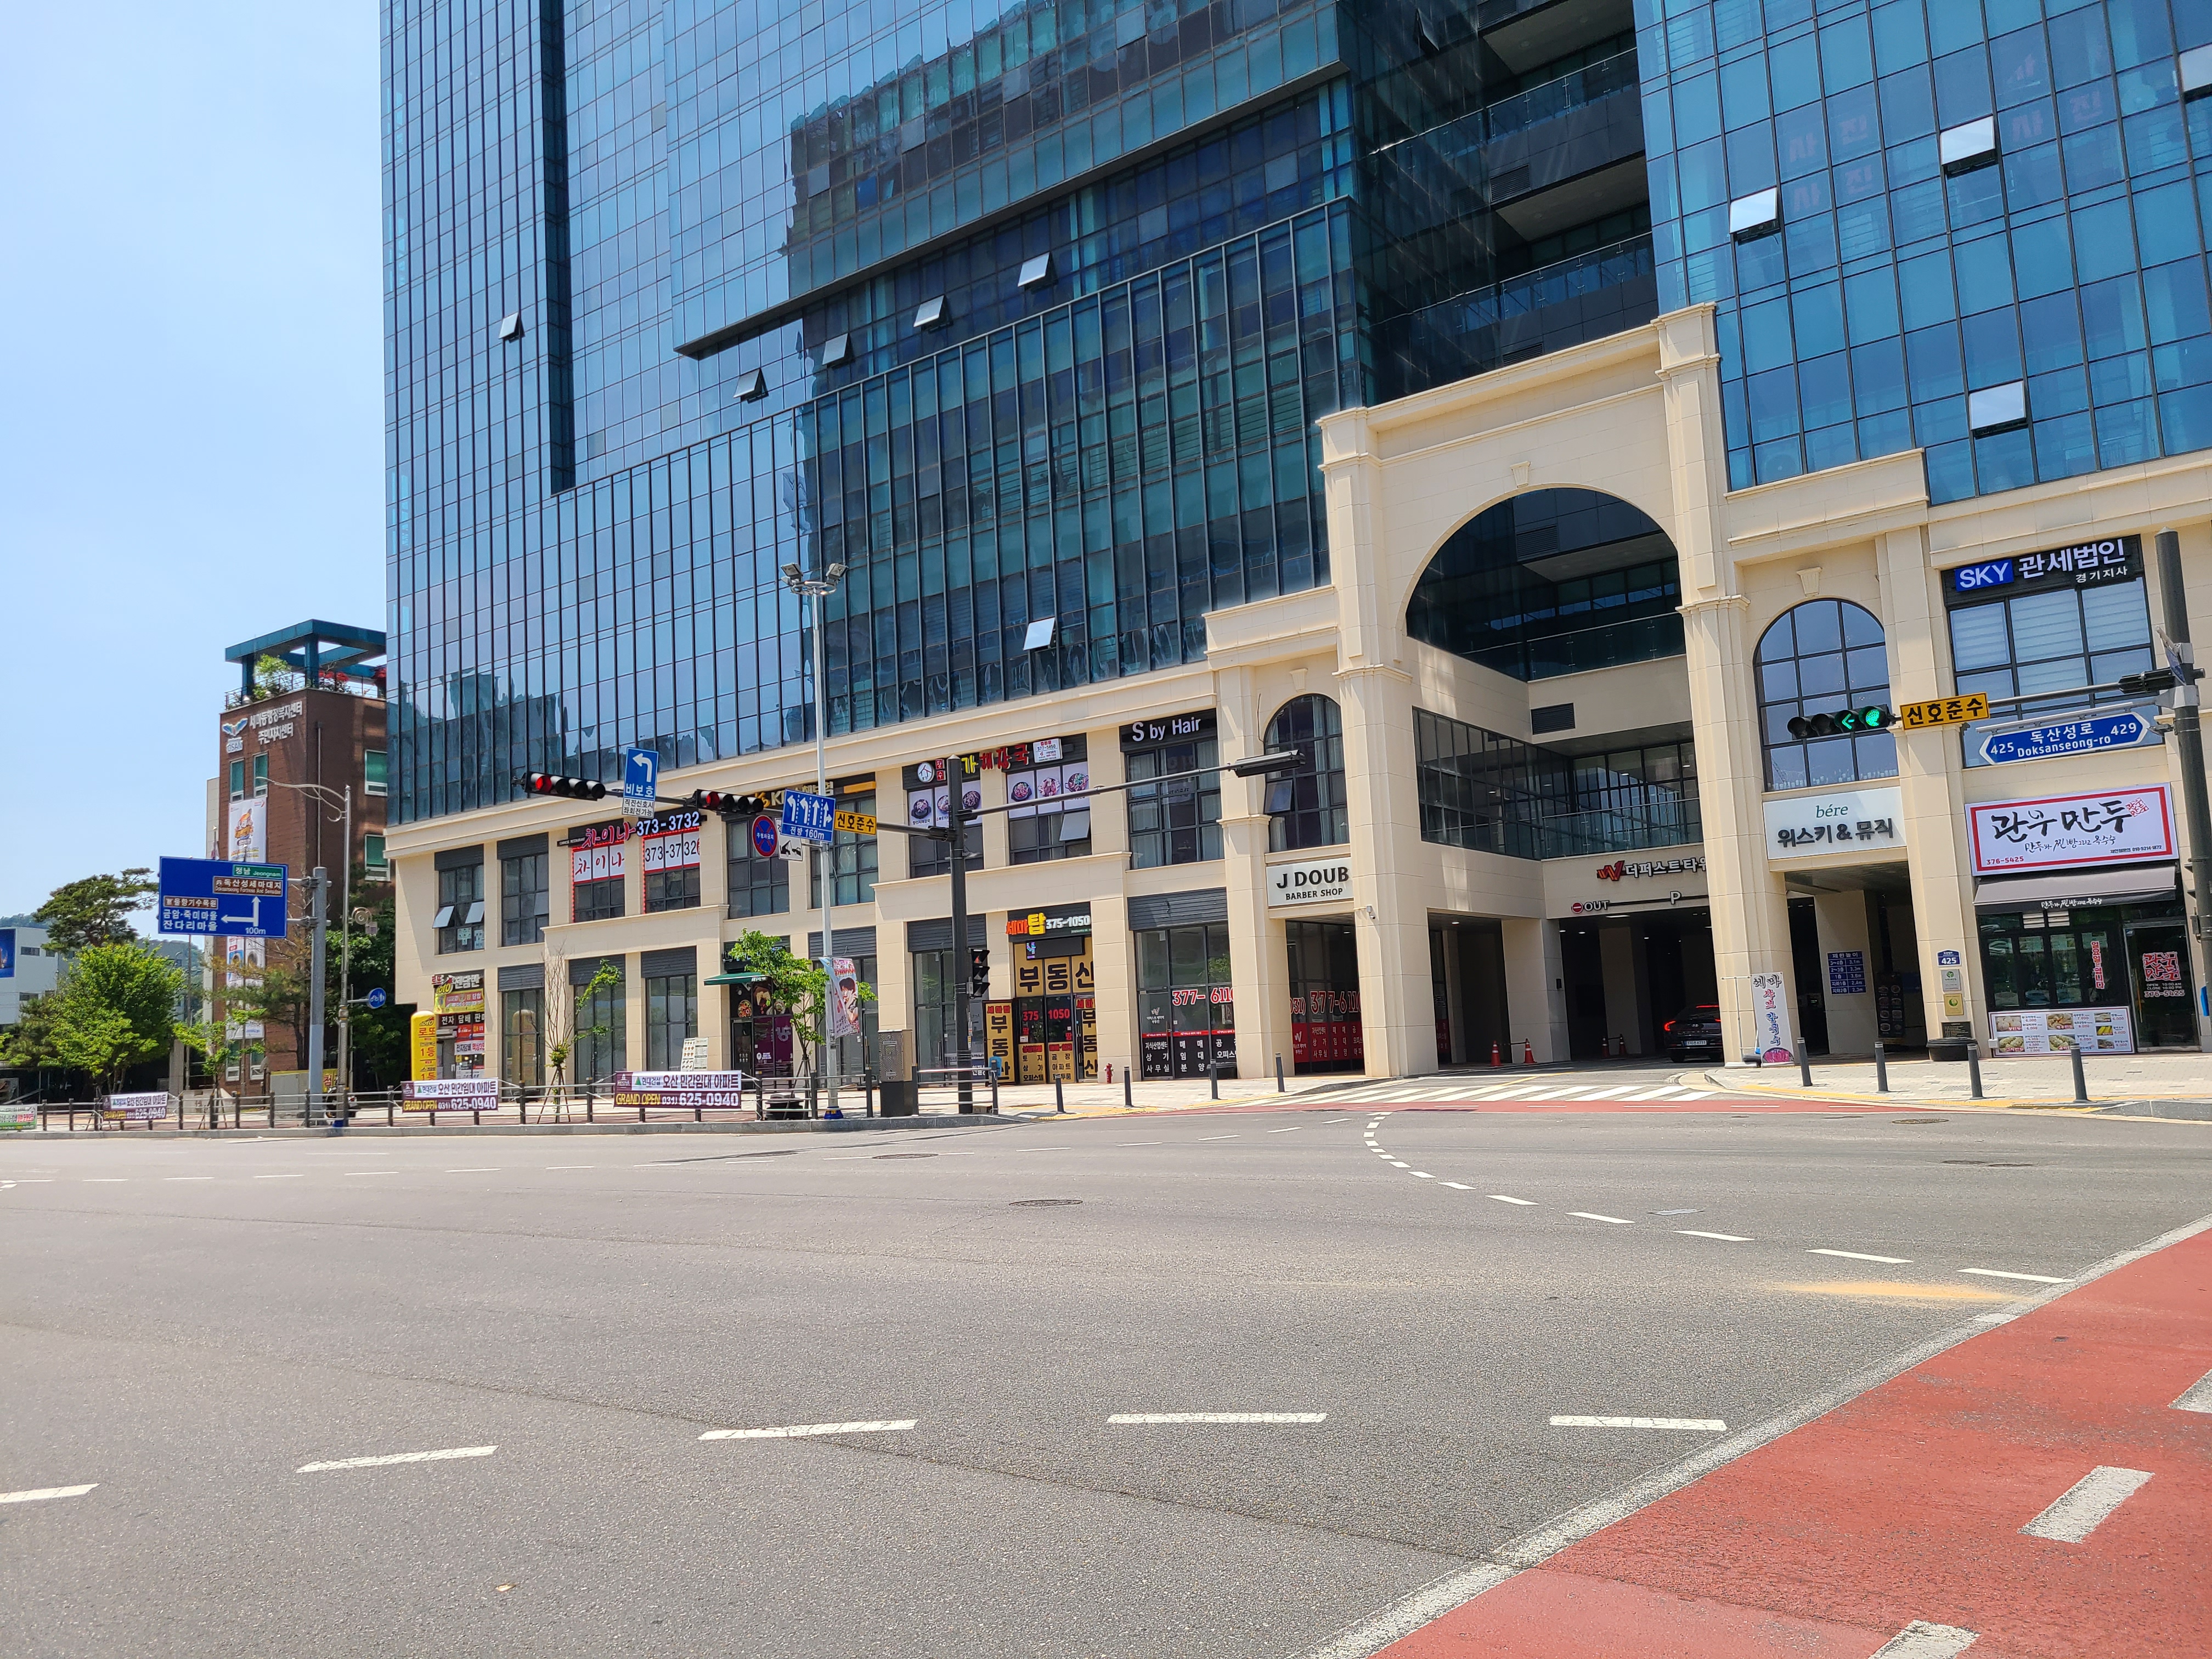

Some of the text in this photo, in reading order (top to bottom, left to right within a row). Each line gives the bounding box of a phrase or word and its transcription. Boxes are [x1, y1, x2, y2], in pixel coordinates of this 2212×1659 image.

[1960, 539, 2125, 588] SKY 관세법인
[2075, 566, 2128, 583] 경기지사
[1907, 697, 1983, 725] 신호준수
[1132, 716, 1201, 742] S by Hair
[2030, 722, 2094, 744] 독산성로
[2110, 723, 2137, 736] 429
[1990, 742, 2015, 755] 425
[2017, 735, 2111, 758] Doksanseong-ro
[626, 783, 654, 798] 비보호
[624, 806, 652, 816] 좌회전가능
[625, 799, 653, 809] 직진신호시
[1815, 803, 1848, 818] bére
[837, 813, 874, 832] 신호준수
[582, 811, 699, 849] 차이나 373-3732
[791, 826, 803, 836] 전방
[805, 829, 825, 839] 160m
[1778, 817, 1894, 848] 위스키 & 뮤직
[2093, 835, 2116, 845] 옥수수
[645, 840, 696, 862] 373-3732
[575, 851, 625, 875] 차이나
[1987, 856, 2024, 865] 376-5425
[235, 867, 251, 875] 정남
[1276, 867, 1349, 889] J DOUB
[224, 879, 281, 889] 독산성세마대지
[1285, 888, 1343, 900] BARBER SHOP
[1670, 891, 1681, 905] P
[1584, 900, 1609, 911] OUT
[163, 920, 218, 932] 잔다리마을
[1006, 912, 1091, 935] 세마탑 375-1050
[1019, 961, 1094, 993] 부동산
[2144, 990, 2185, 998] 376-5425
[1076, 998, 1095, 1008] 세마
[1023, 1008, 1070, 1021] 375 1050
[419, 1028, 435, 1036] 로또
[1216, 1050, 1237, 1059] 오피스
[438, 1080, 496, 1095] 오산 민간임대 아파트
[663, 1074, 738, 1088] 오산 민간임대 아파트
[451, 1097, 496, 1110] 625-0940
[616, 1092, 738, 1107] GRAND OPEN 031) 625-0940
